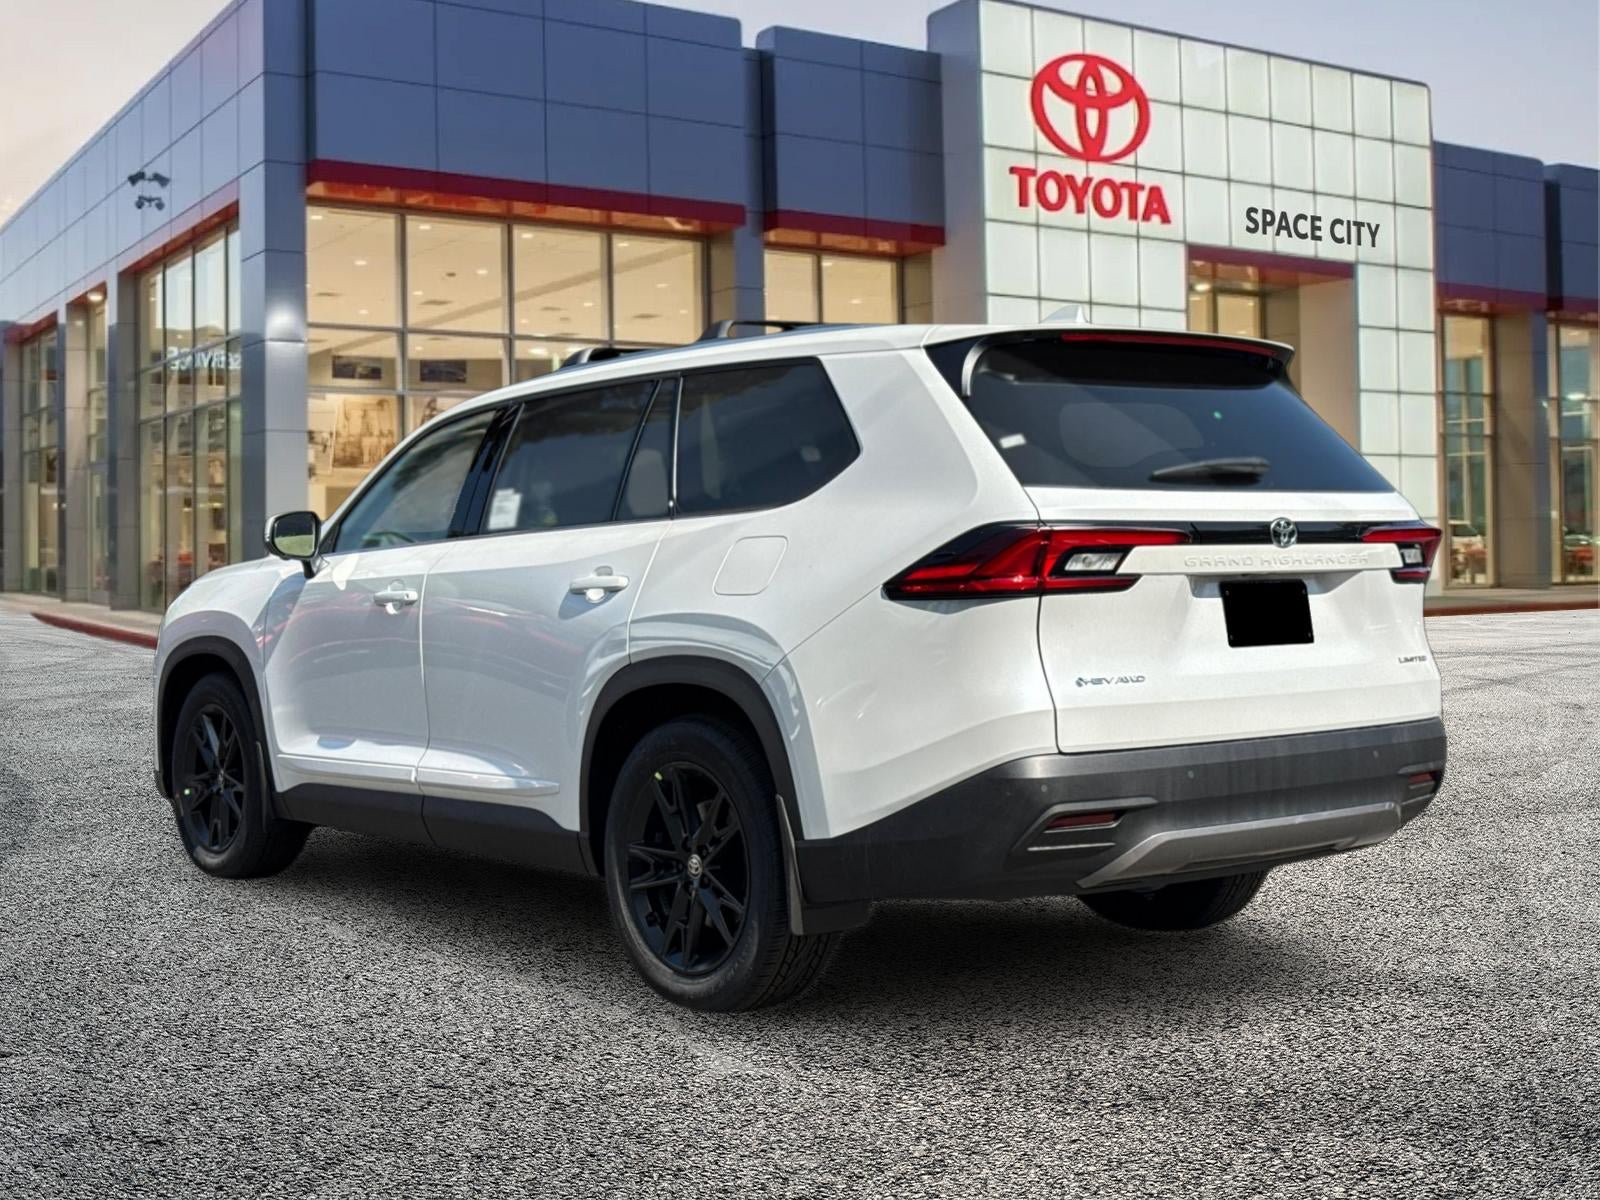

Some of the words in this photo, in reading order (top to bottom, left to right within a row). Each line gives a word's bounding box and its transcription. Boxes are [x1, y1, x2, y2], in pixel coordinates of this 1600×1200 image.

[1009, 166, 1171, 224] TOYOTA
[1245, 207, 1323, 242] SPACE
[1329, 217, 1381, 248] CITY
[1184, 555, 1254, 568] GRAND
[1260, 553, 1369, 567] HIGHLANDER
